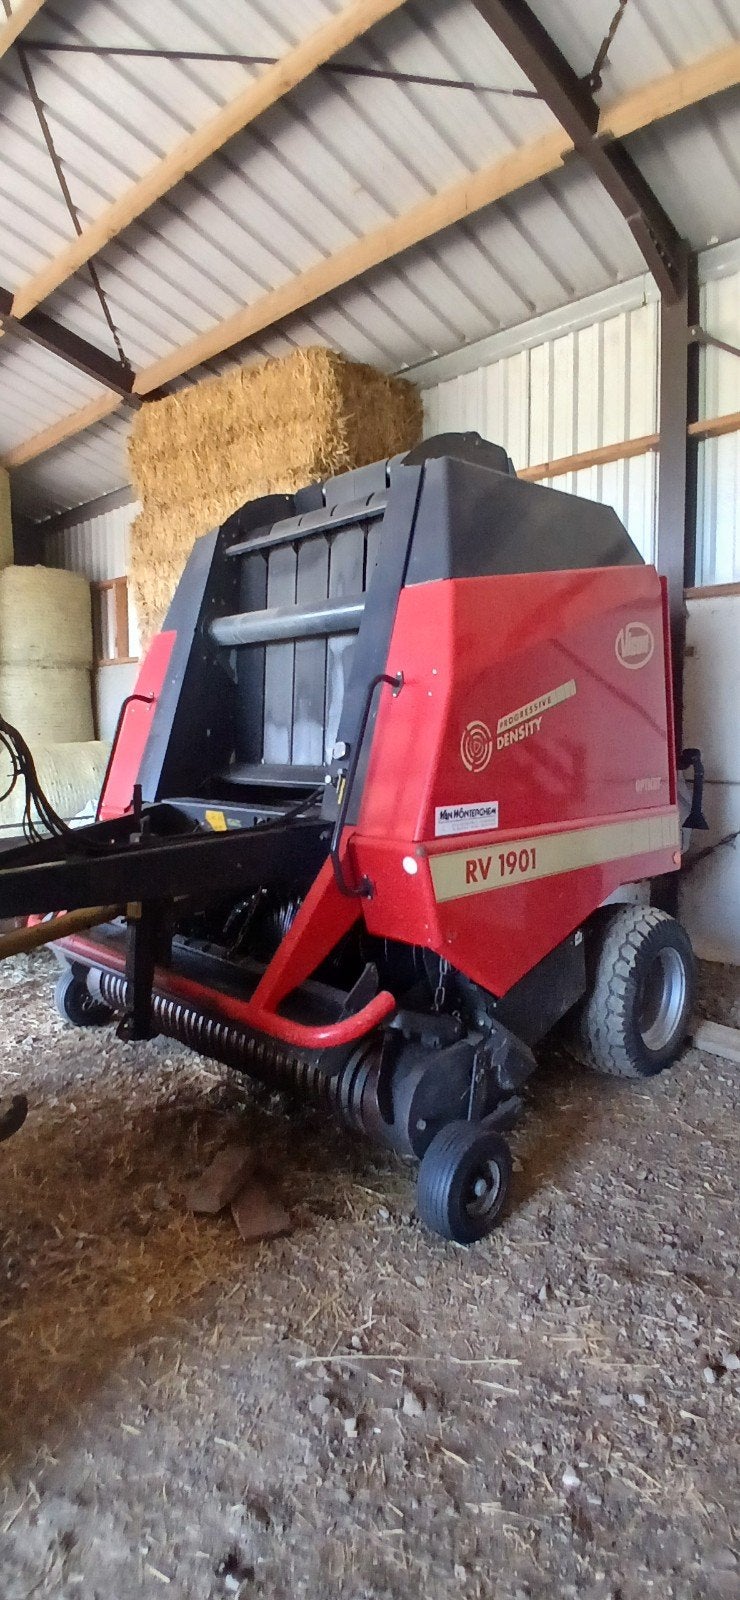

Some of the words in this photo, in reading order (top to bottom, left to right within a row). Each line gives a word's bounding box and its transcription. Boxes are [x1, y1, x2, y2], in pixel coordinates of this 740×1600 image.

[499, 696, 552, 729] PROGRESSIVE
[497, 716, 543, 750] DENSITY
[466, 856, 492, 884] RV
[498, 847, 537, 877] 1901
